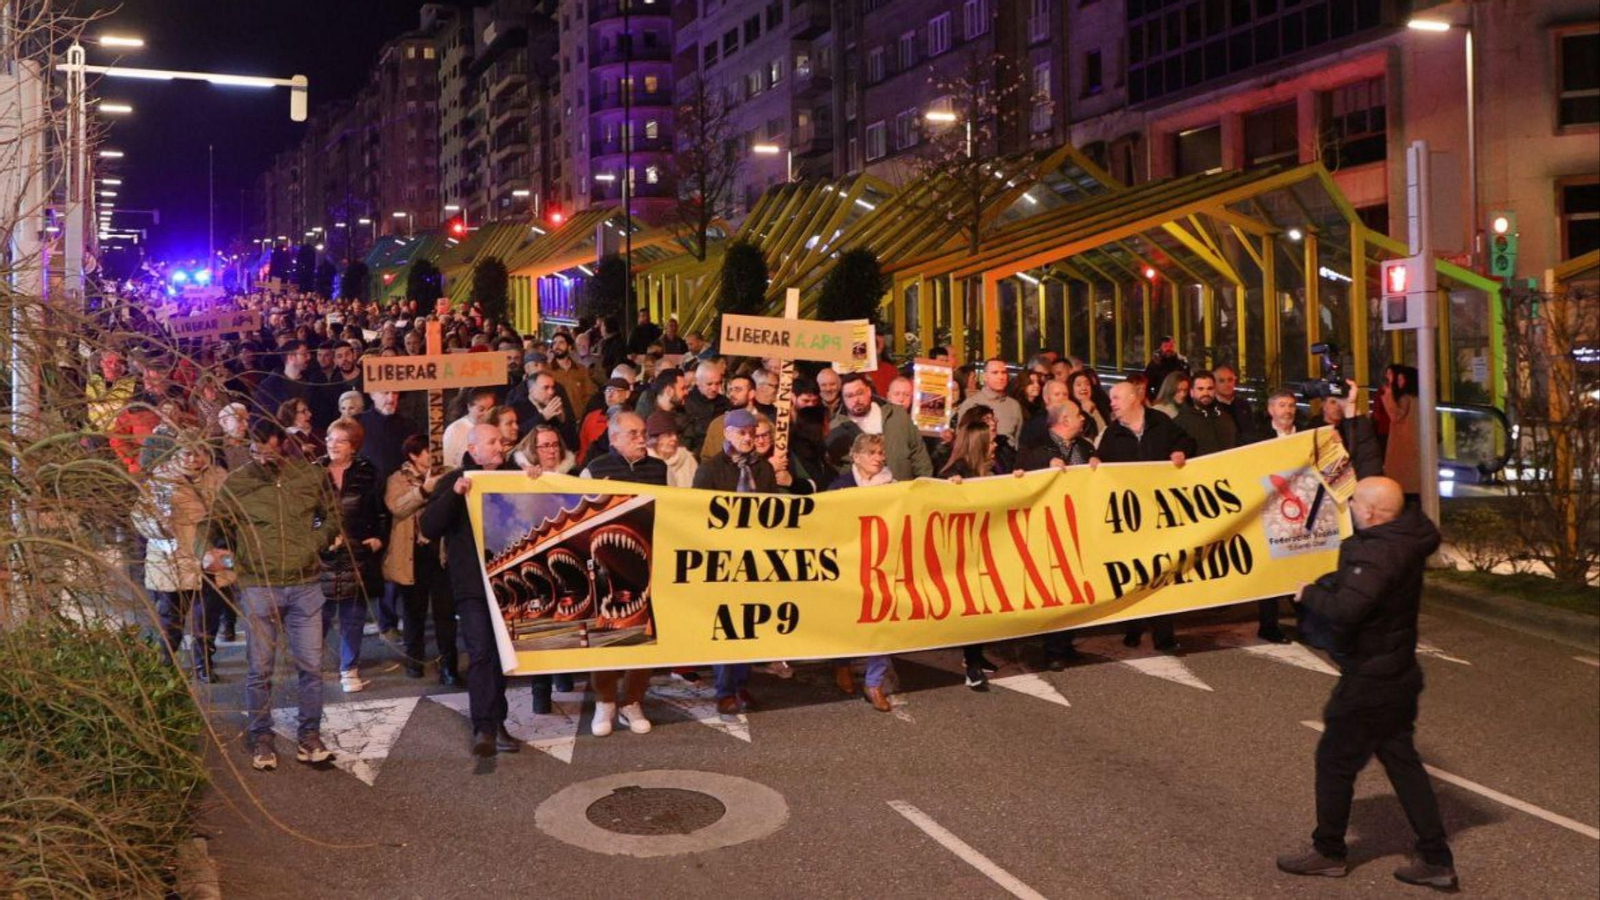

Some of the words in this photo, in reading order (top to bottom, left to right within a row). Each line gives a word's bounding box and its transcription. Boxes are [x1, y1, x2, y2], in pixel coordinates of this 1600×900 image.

[726, 326, 790, 347] LIBERAR
[367, 363, 437, 382] LIBERAR
[443, 362, 454, 377] A
[707, 494, 815, 530] STOP
[1104, 489, 1142, 534] 40
[1157, 479, 1243, 530] ANOS
[673, 547, 840, 584] PEAXES
[1103, 533, 1253, 599] PAGANDO
[711, 601, 800, 641] AP9
